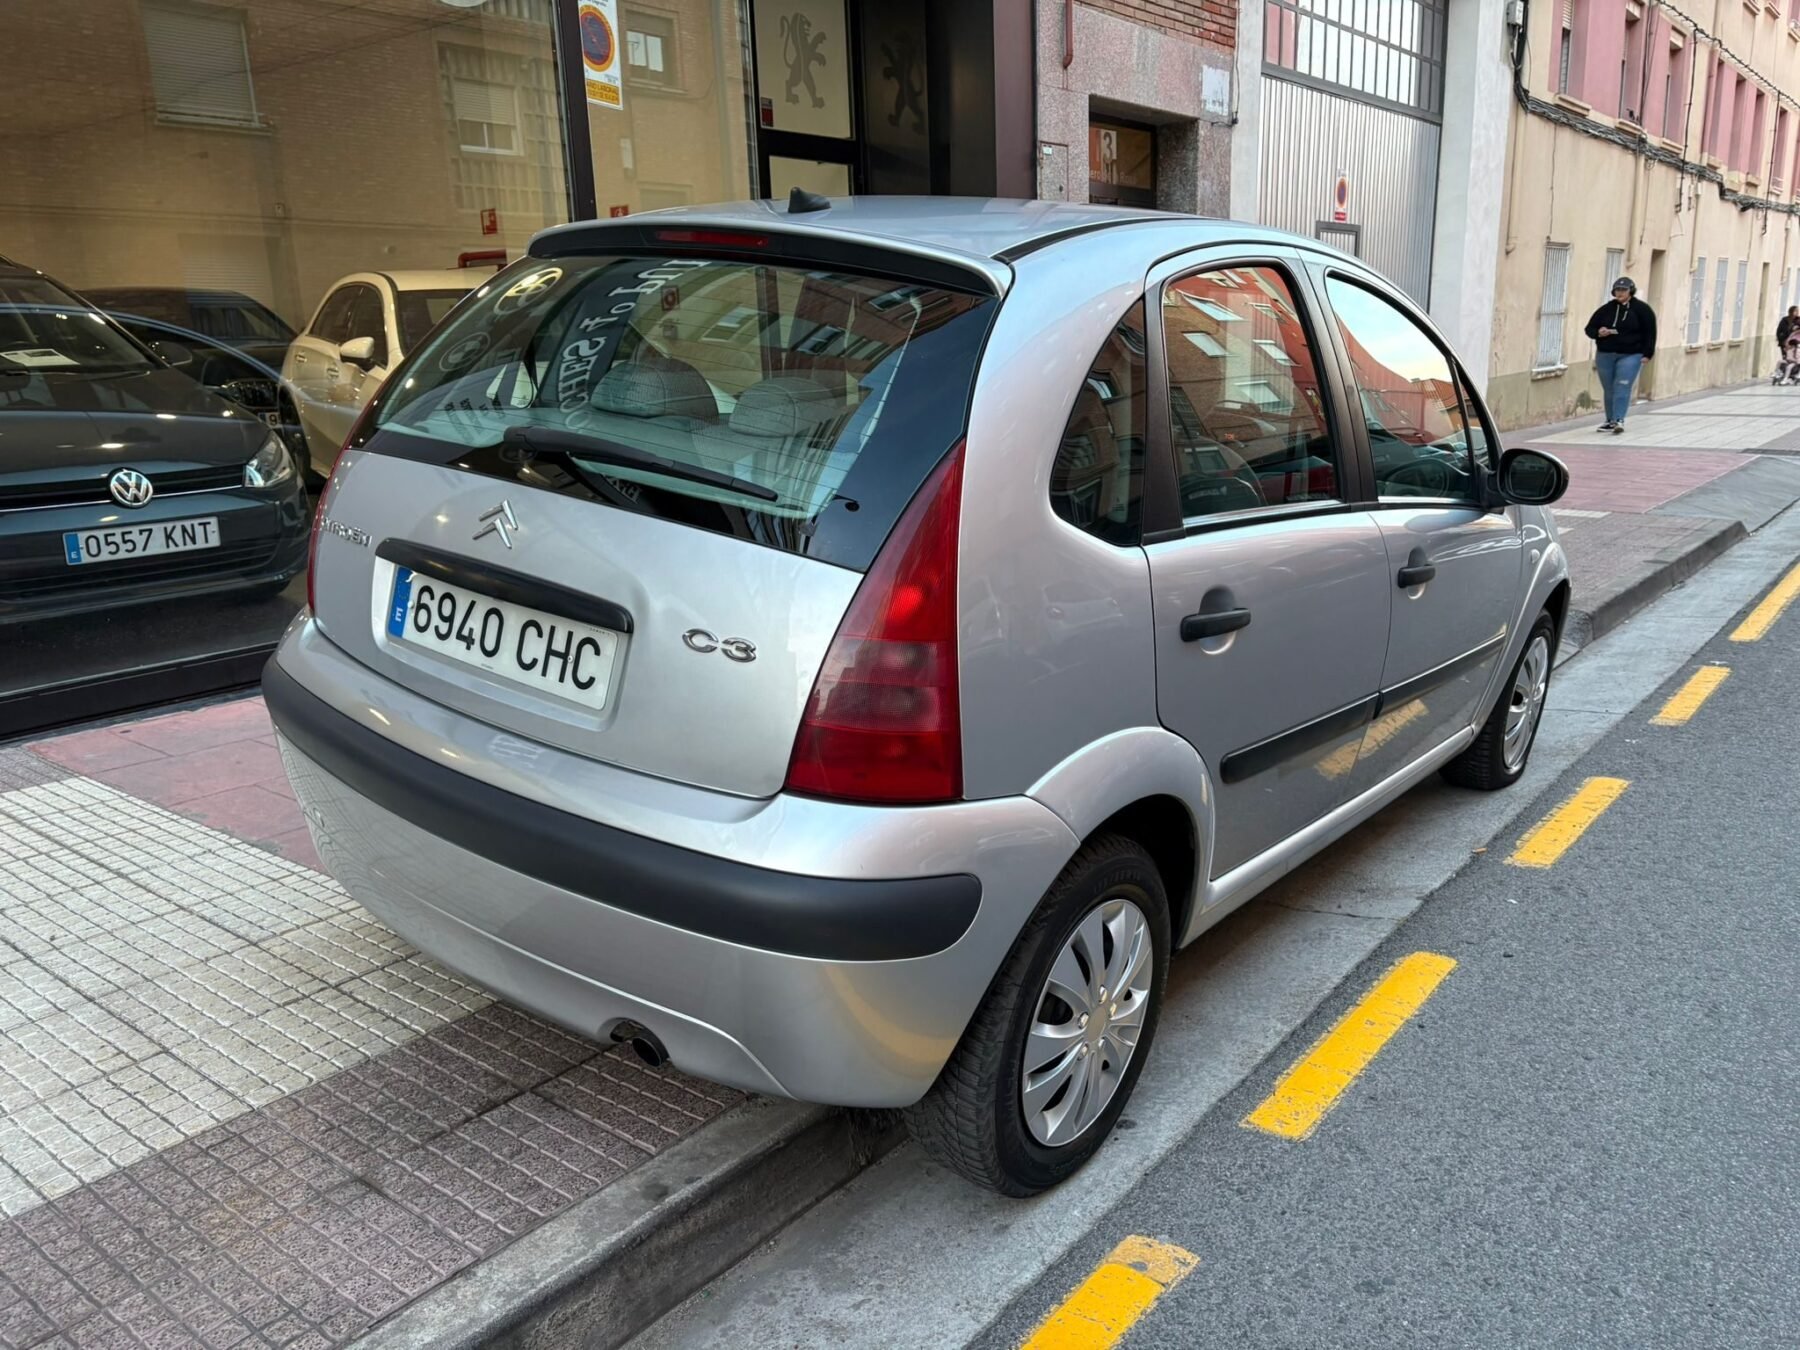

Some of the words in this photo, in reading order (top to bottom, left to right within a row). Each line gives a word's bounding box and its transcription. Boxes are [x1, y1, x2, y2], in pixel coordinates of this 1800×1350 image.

[71, 551, 79, 559] E
[84, 528, 153, 558] 0557
[163, 521, 212, 549] KNT
[395, 606, 403, 622] E
[413, 585, 504, 658] 6940
[516, 619, 601, 690] CHC
[682, 628, 757, 663] C3
